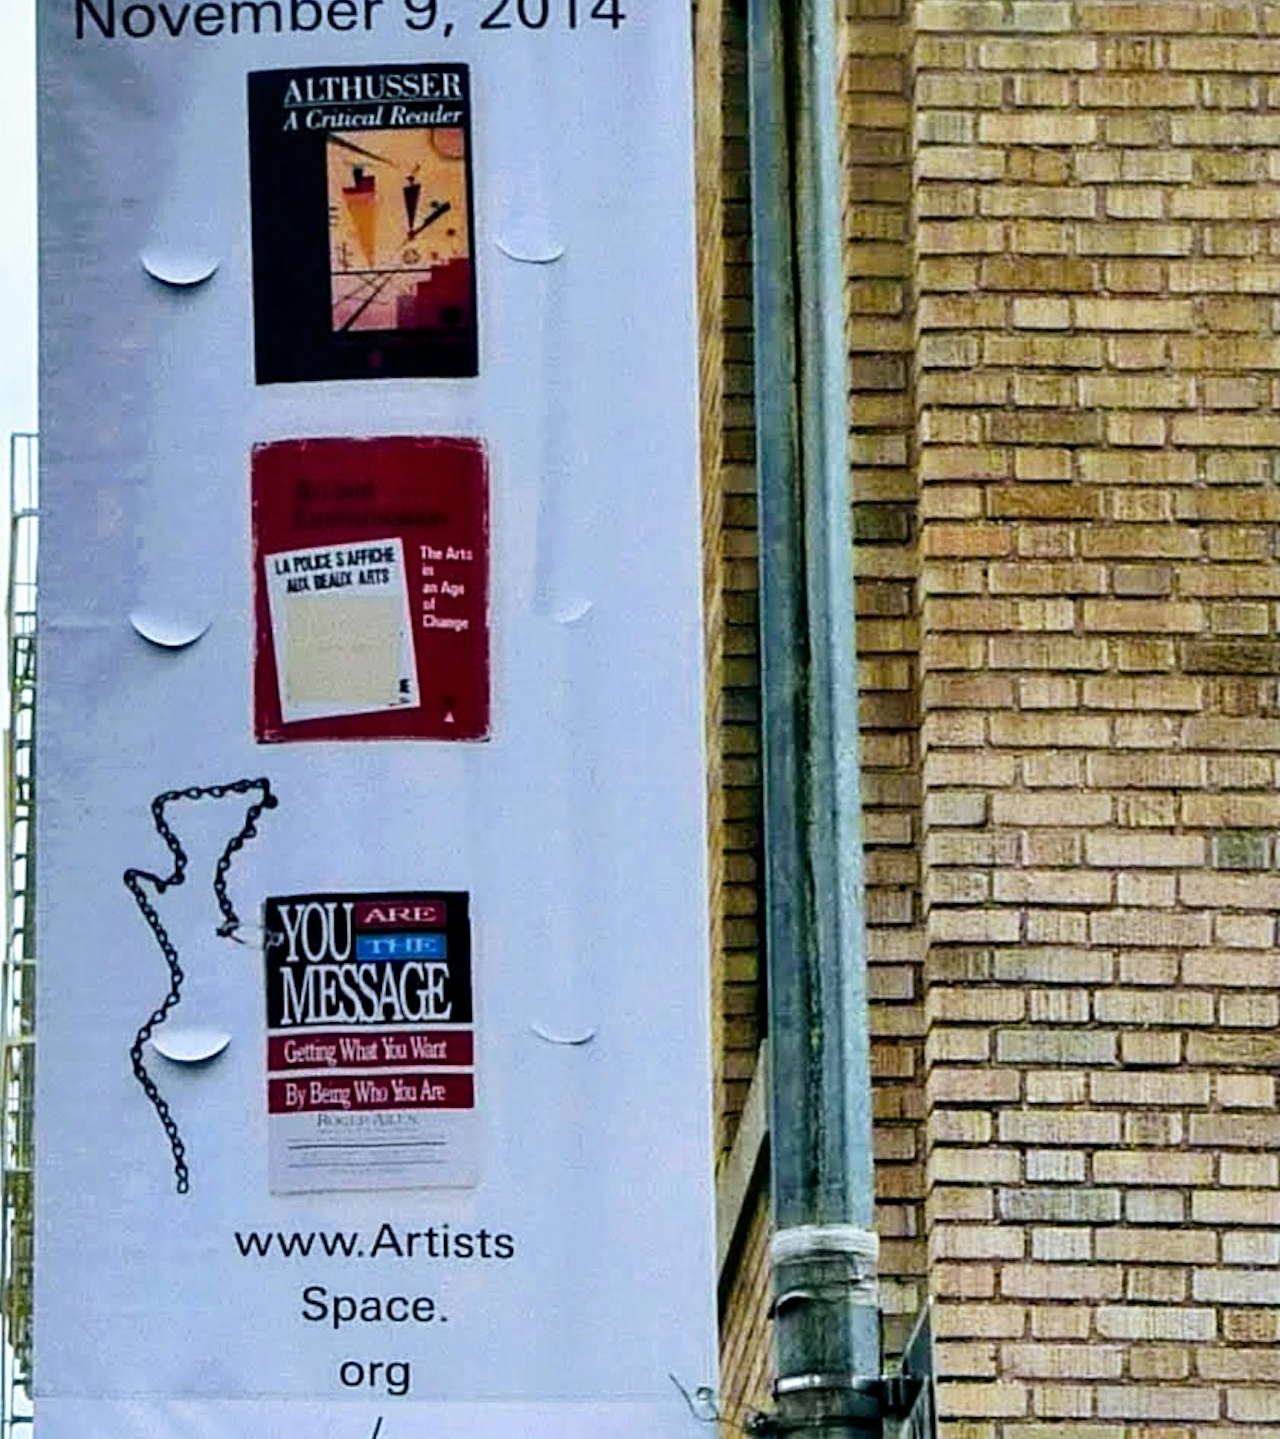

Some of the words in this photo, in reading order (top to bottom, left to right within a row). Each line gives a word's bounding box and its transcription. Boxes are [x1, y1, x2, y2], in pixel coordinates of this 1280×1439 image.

[283, 73, 463, 103] ALTHUSSER
[283, 109, 300, 131] A
[304, 106, 383, 128] Critical
[389, 106, 464, 127] Reader
[275, 558, 290, 575] LA
[293, 553, 332, 572] POLICE
[419, 545, 443, 560] The
[446, 546, 473, 561] Arts
[359, 568, 390, 585] ARTS
[422, 583, 438, 594] an
[440, 580, 465, 598] Age
[423, 597, 435, 611] of
[422, 614, 469, 632] Change
[363, 907, 437, 923] ARE
[277, 902, 354, 962] YOU
[366, 937, 437, 954] THE
[279, 962, 452, 1025] MESSAGE
[284, 1039, 337, 1066] Getting
[339, 1037, 378, 1062] What
[382, 1036, 407, 1060] You
[410, 1035, 447, 1060] Want
[285, 1082, 306, 1109] By
[309, 1081, 351, 1108] Being
[353, 1080, 389, 1102] Who
[390, 1079, 417, 1102] You
[420, 1077, 446, 1101] Are
[235, 1222, 515, 1260] www.Artists
[301, 1286, 449, 1328] Space.
[339, 1358, 410, 1395] org
